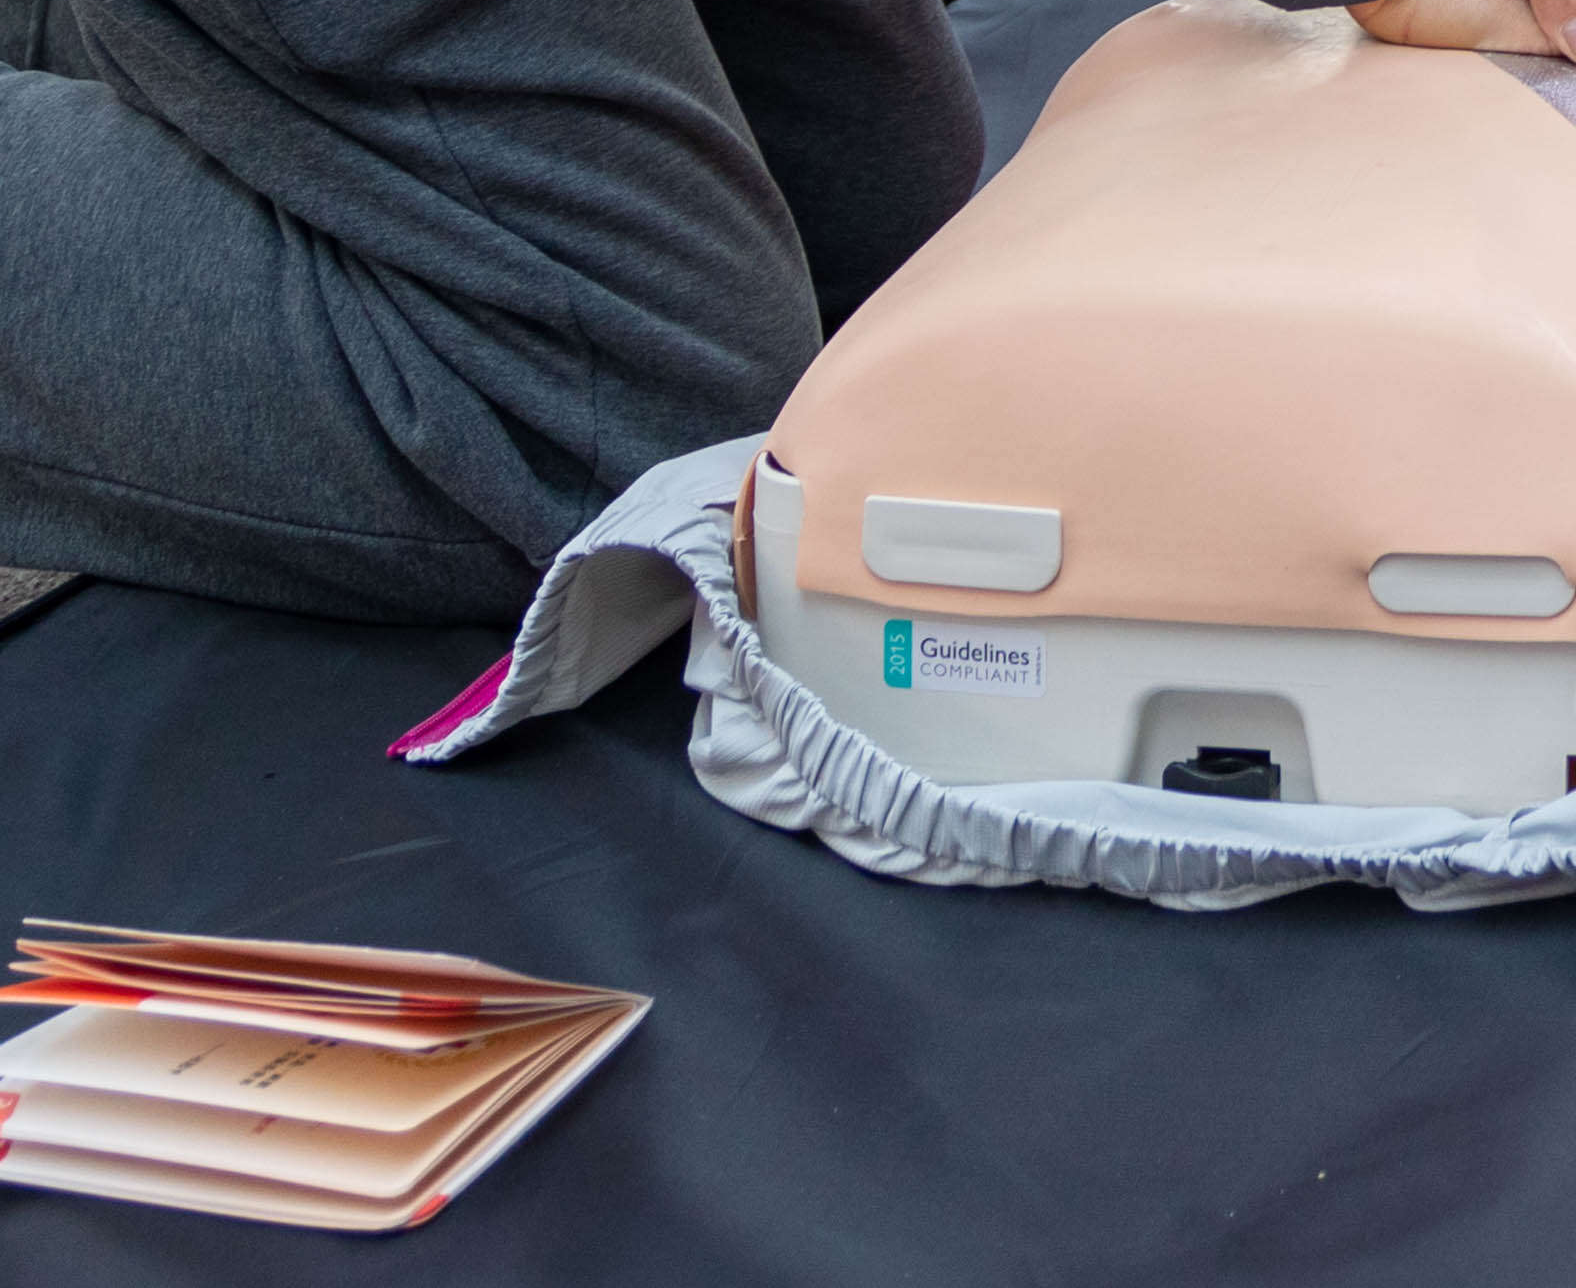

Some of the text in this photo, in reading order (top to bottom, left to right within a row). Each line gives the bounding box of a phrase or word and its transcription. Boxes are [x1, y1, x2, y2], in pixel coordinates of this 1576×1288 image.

[889, 633, 906, 675] 2015
[920, 637, 1030, 665] Guidelines
[920, 662, 1028, 685] COMPLIANT
